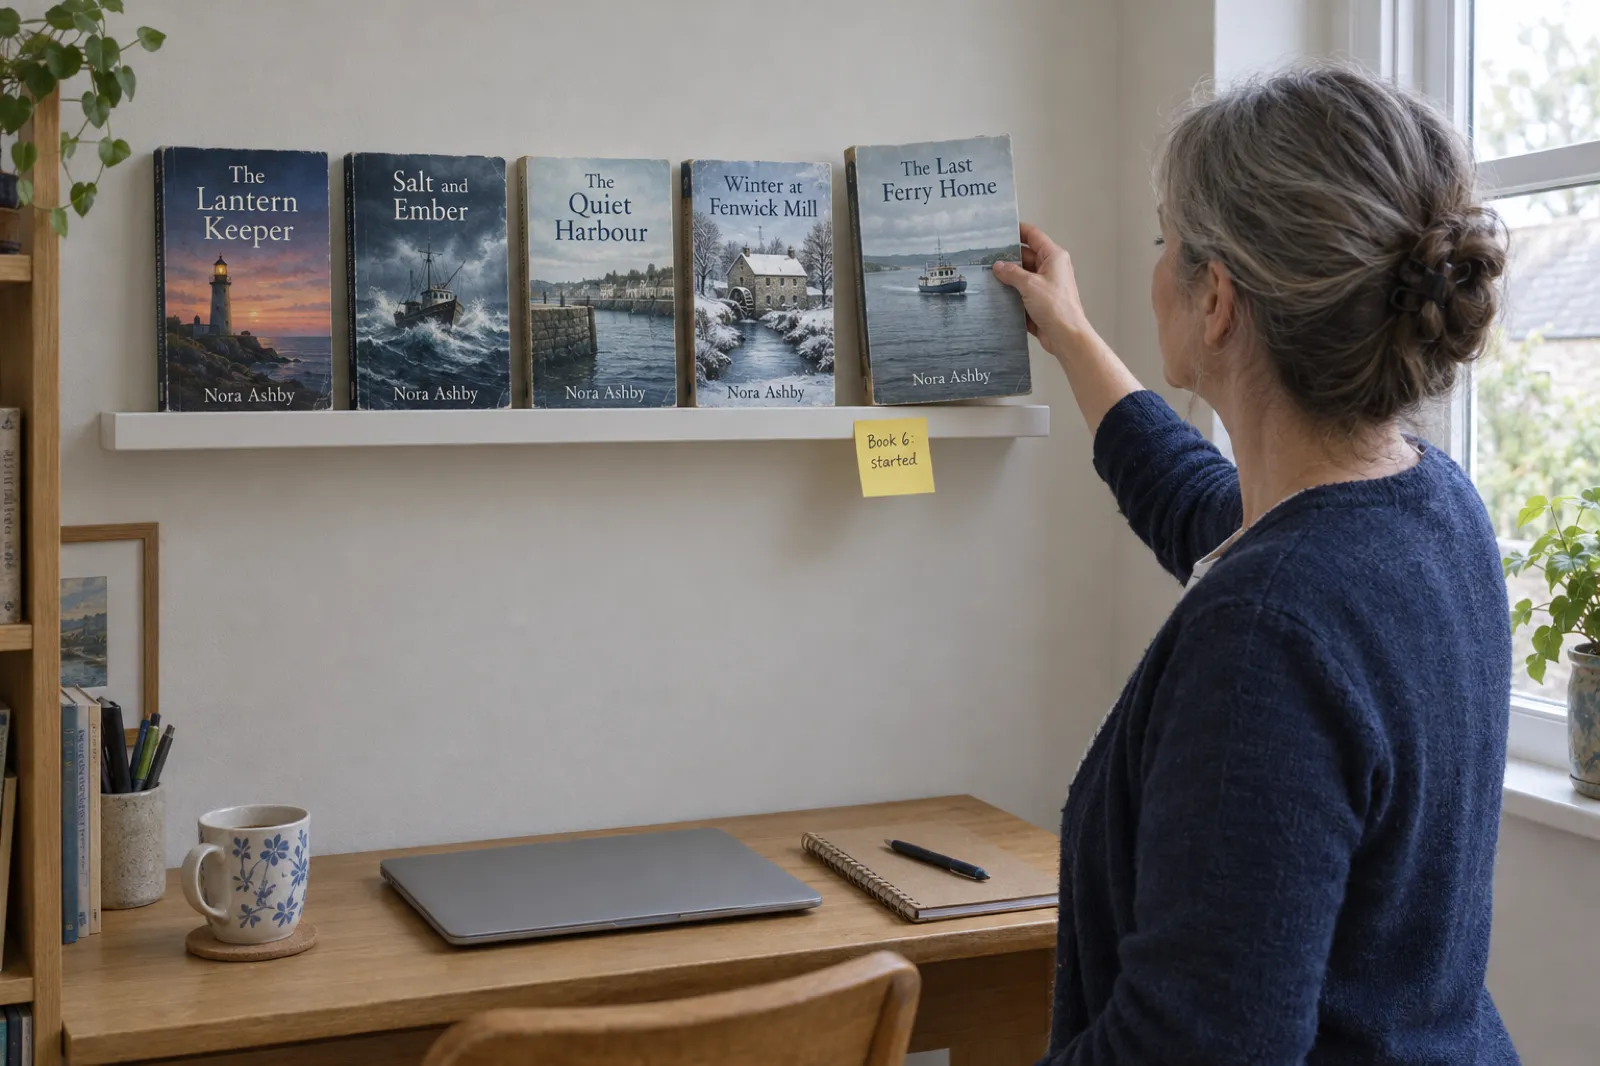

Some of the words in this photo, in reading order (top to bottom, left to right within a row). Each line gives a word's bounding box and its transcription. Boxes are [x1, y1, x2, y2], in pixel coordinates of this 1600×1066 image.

[229, 165, 265, 185] The
[900, 160, 930, 177] The
[936, 157, 973, 175] Last
[393, 170, 434, 193] Salt
[441, 179, 469, 193] and
[585, 173, 615, 189] The
[723, 175, 783, 194] Winter
[789, 181, 803, 194] at
[882, 182, 932, 205] Ferry
[939, 177, 998, 199] Home
[196, 187, 299, 213] Lantern
[394, 198, 469, 222] Ember
[569, 192, 632, 218] Quiet
[709, 197, 778, 217] Fenwick
[784, 199, 818, 217] Mill
[203, 216, 294, 249] Keeper
[555, 219, 648, 242] Harbour
[912, 372, 946, 387] Nora
[949, 369, 991, 385] Ashby
[204, 387, 242, 404] Nora
[248, 387, 295, 406] Ashby
[393, 386, 431, 402] Nora
[434, 386, 478, 404] Ashby
[565, 385, 599, 400] Nora
[603, 385, 646, 403] Ashby
[727, 385, 760, 400] Nora
[765, 385, 805, 402] Ashby
[867, 433, 897, 449] Book
[901, 431, 915, 447] 6:
[870, 453, 918, 469] started
